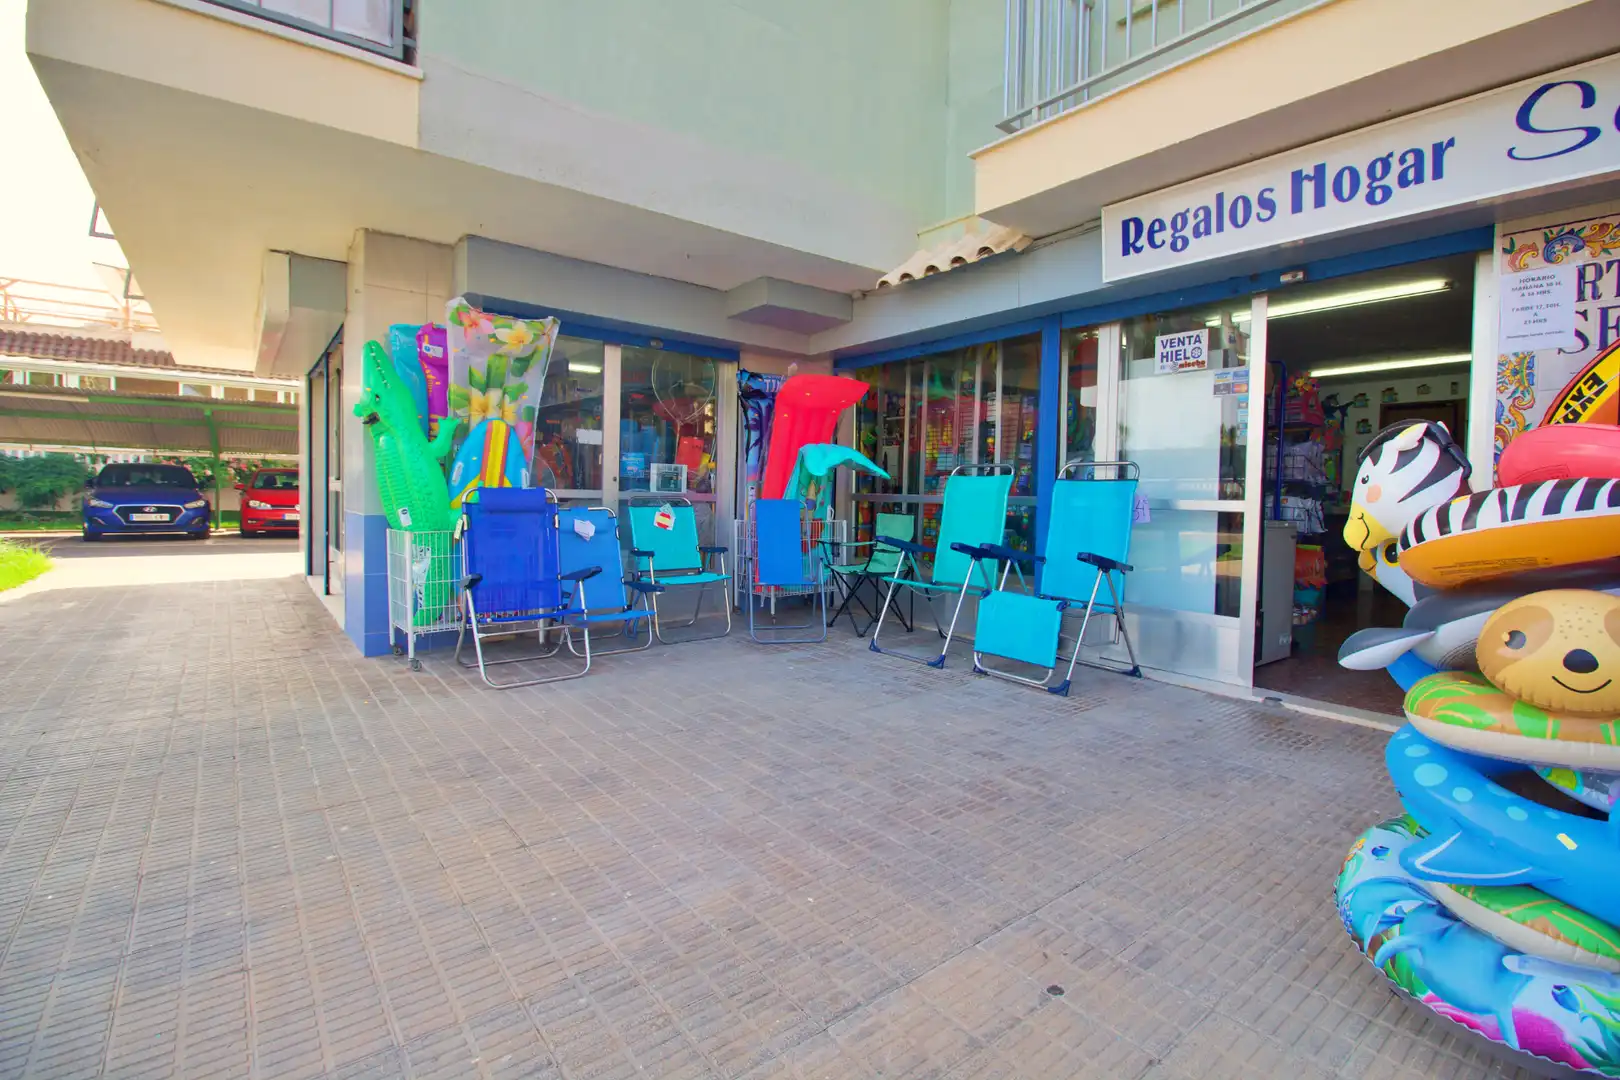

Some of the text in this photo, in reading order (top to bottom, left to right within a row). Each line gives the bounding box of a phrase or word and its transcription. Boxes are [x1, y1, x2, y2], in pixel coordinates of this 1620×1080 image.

[1121, 80, 1620, 257] Regalos Hogar S
[1519, 274, 1556, 284] HORARIO
[1160, 334, 1202, 350] VENTA
[1160, 346, 1203, 363] HIELO
[1555, 371, 1608, 424] EXP
